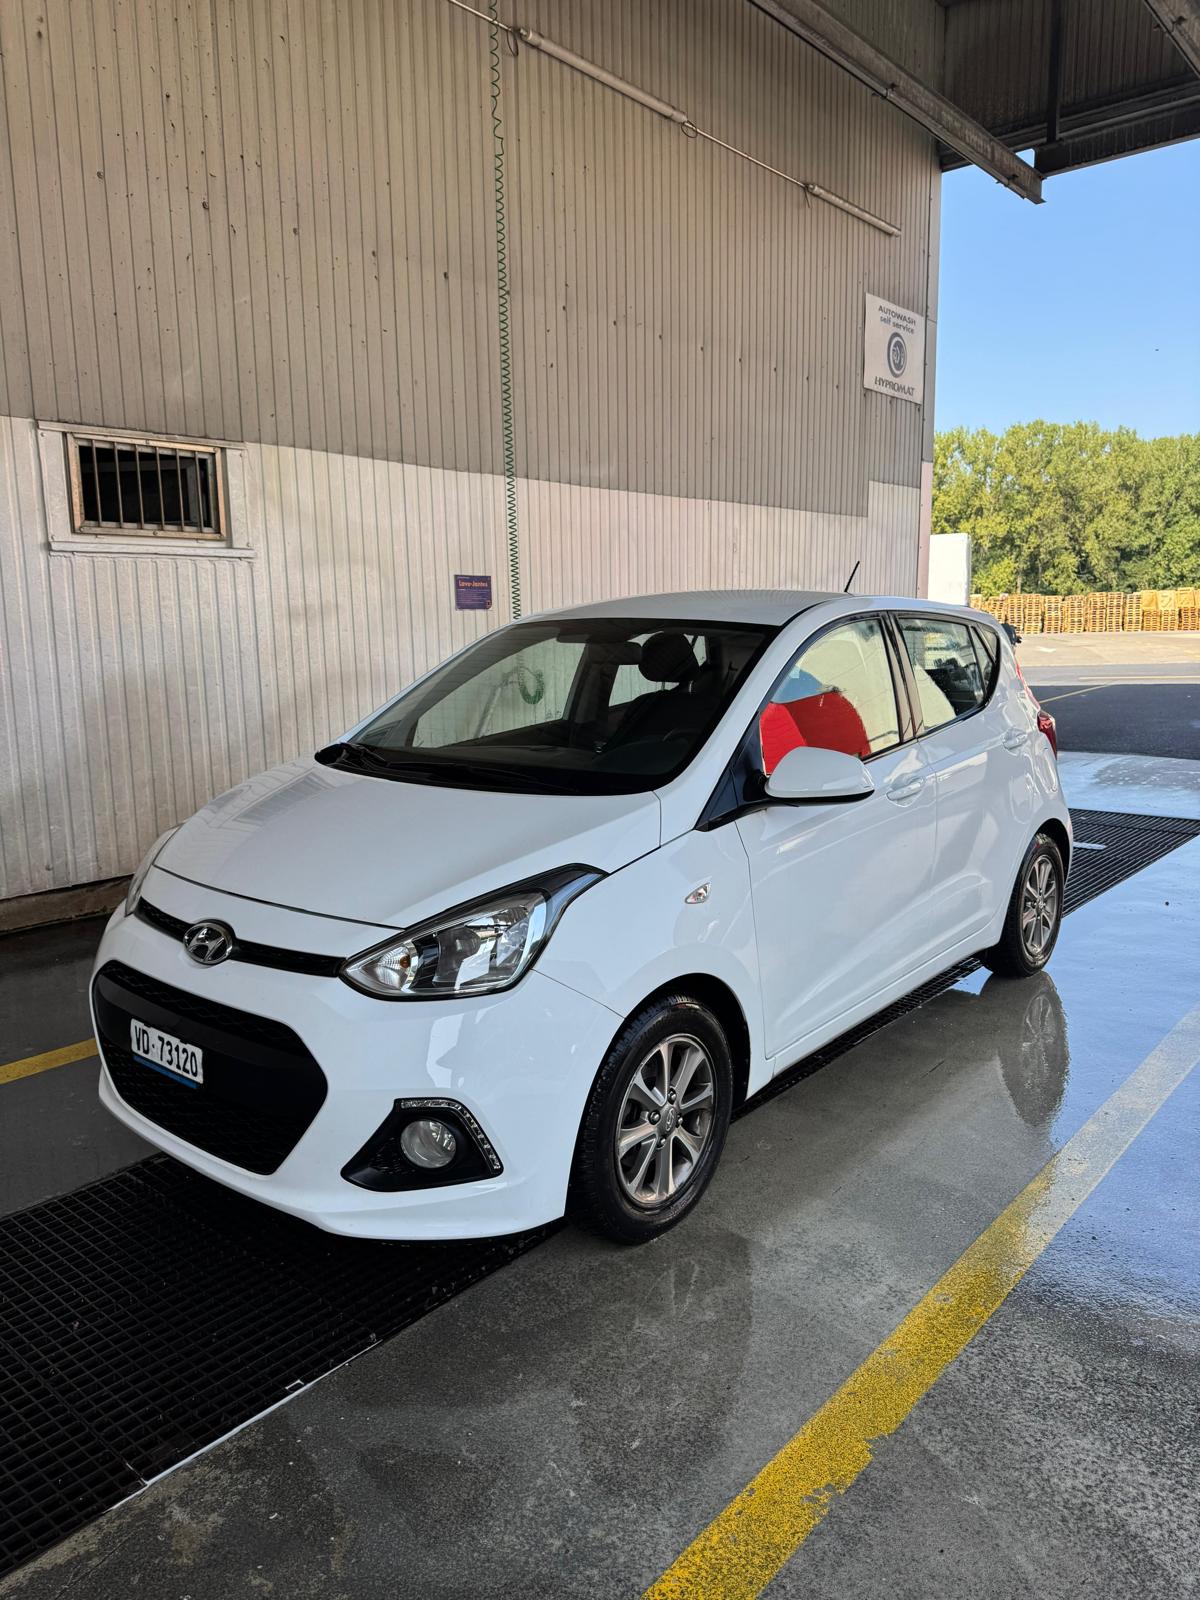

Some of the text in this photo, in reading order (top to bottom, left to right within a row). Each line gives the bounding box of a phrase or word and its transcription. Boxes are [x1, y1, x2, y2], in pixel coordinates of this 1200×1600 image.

[878, 304, 916, 326] AUTOWASH
[880, 315, 914, 335] self service
[874, 376, 916, 396] HYPROMAT
